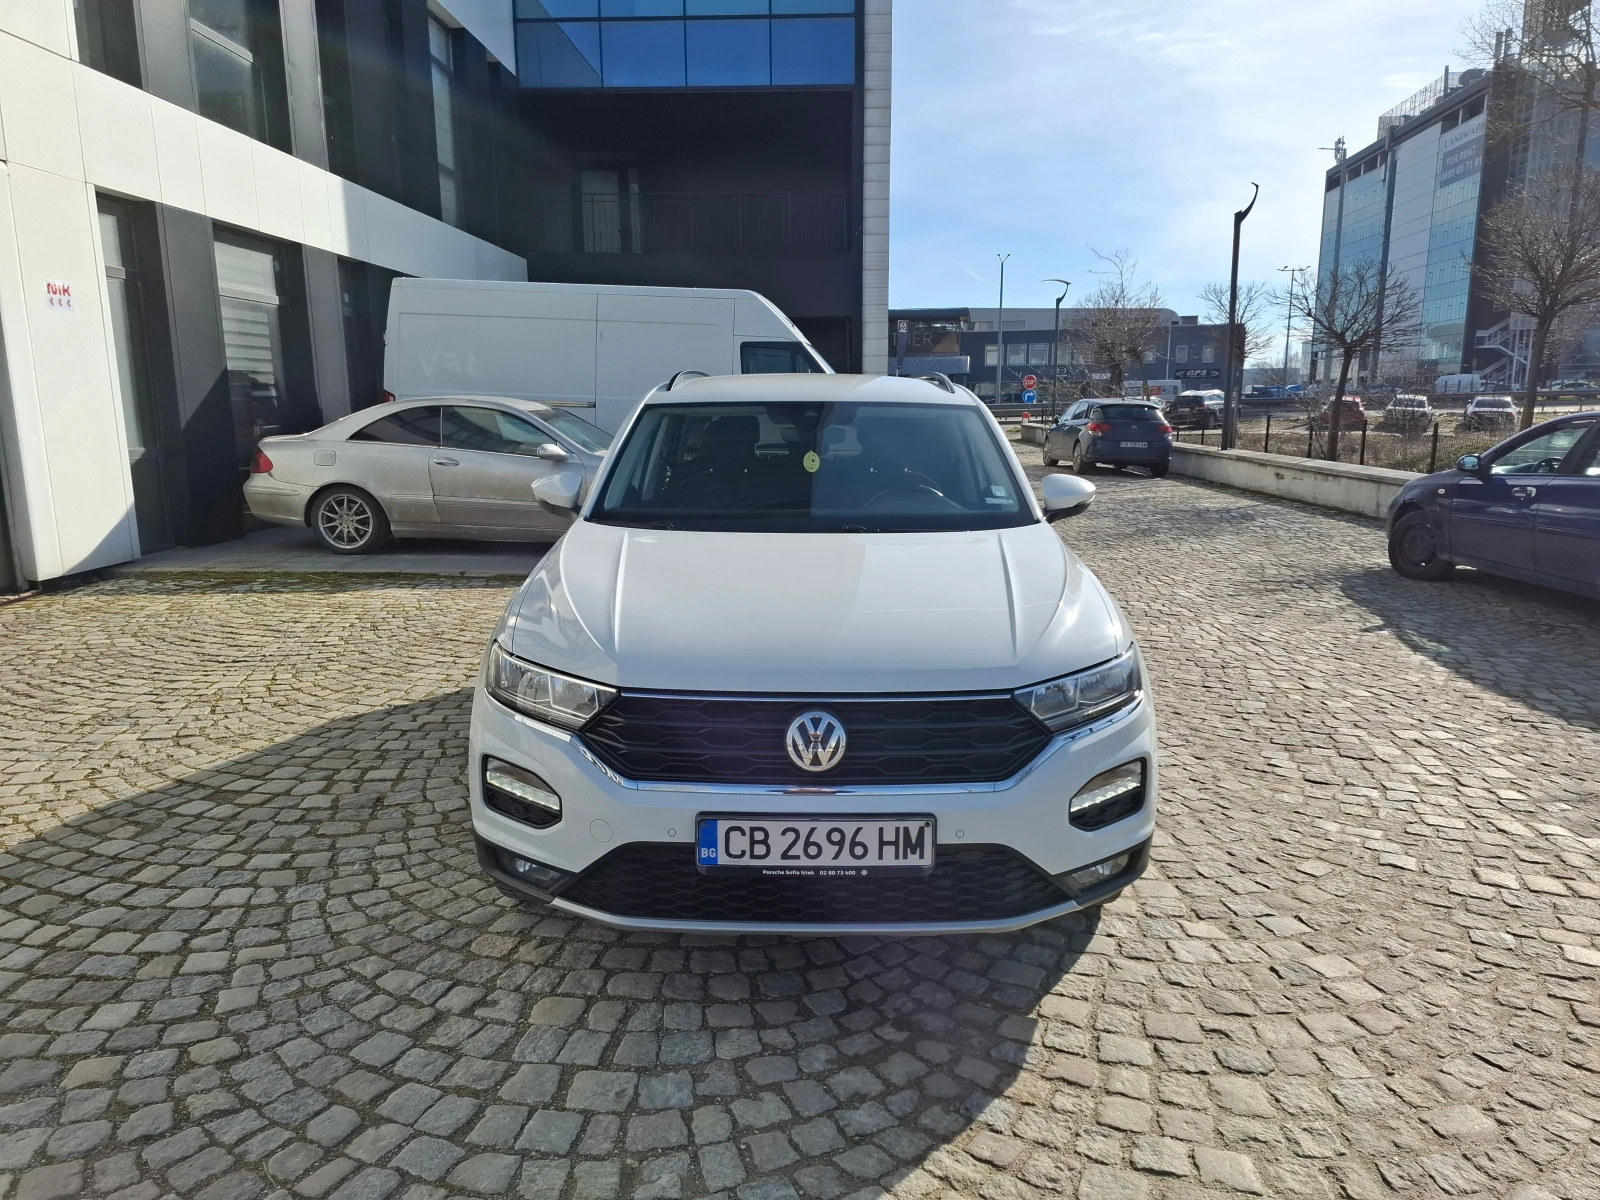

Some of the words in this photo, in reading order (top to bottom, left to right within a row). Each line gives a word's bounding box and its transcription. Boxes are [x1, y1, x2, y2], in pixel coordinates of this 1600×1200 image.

[1446, 154, 1459, 166] FOR
[47, 282, 71, 297] NIK
[701, 847, 716, 858] BG
[724, 825, 771, 860] CB
[780, 826, 869, 860] 2696
[877, 826, 925, 860] HM
